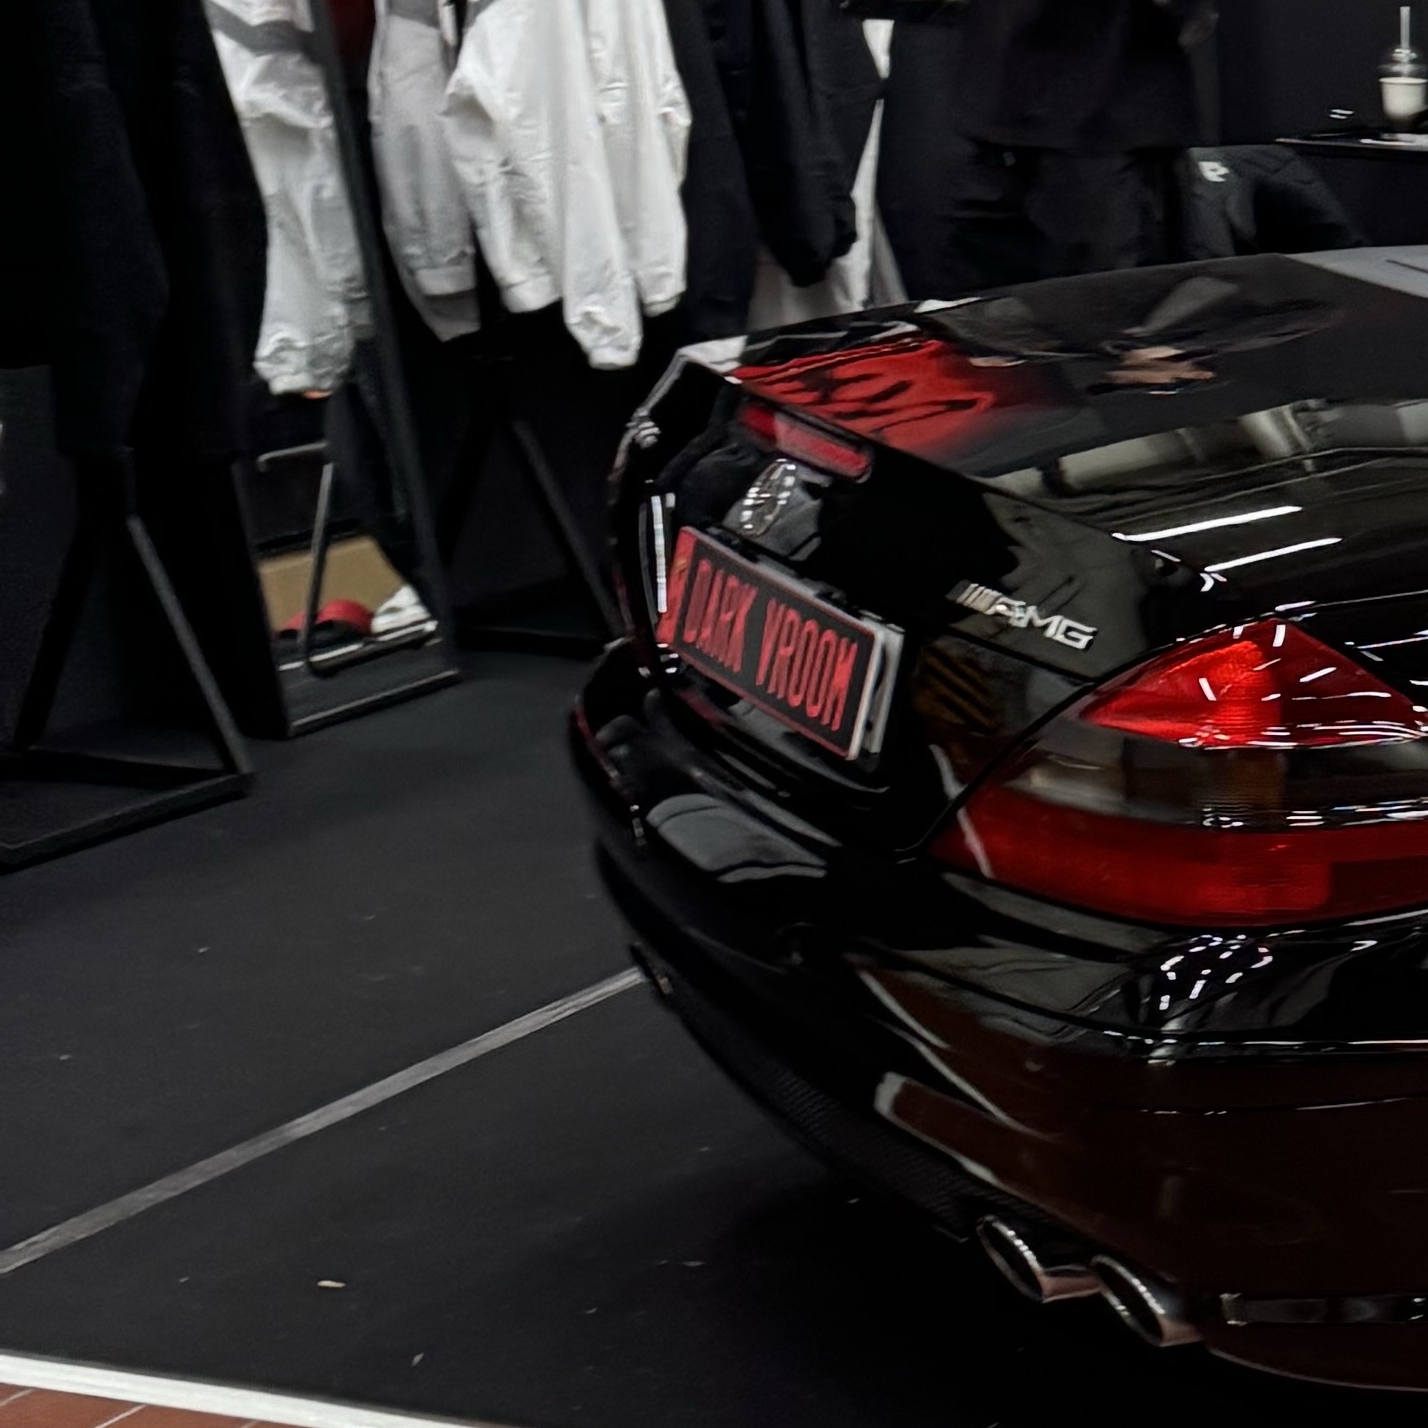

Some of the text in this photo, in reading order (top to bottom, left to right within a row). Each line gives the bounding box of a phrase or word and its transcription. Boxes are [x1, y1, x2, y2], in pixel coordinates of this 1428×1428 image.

[684, 558, 858, 732] DARK VROOM
[976, 590, 1099, 650] AMG
